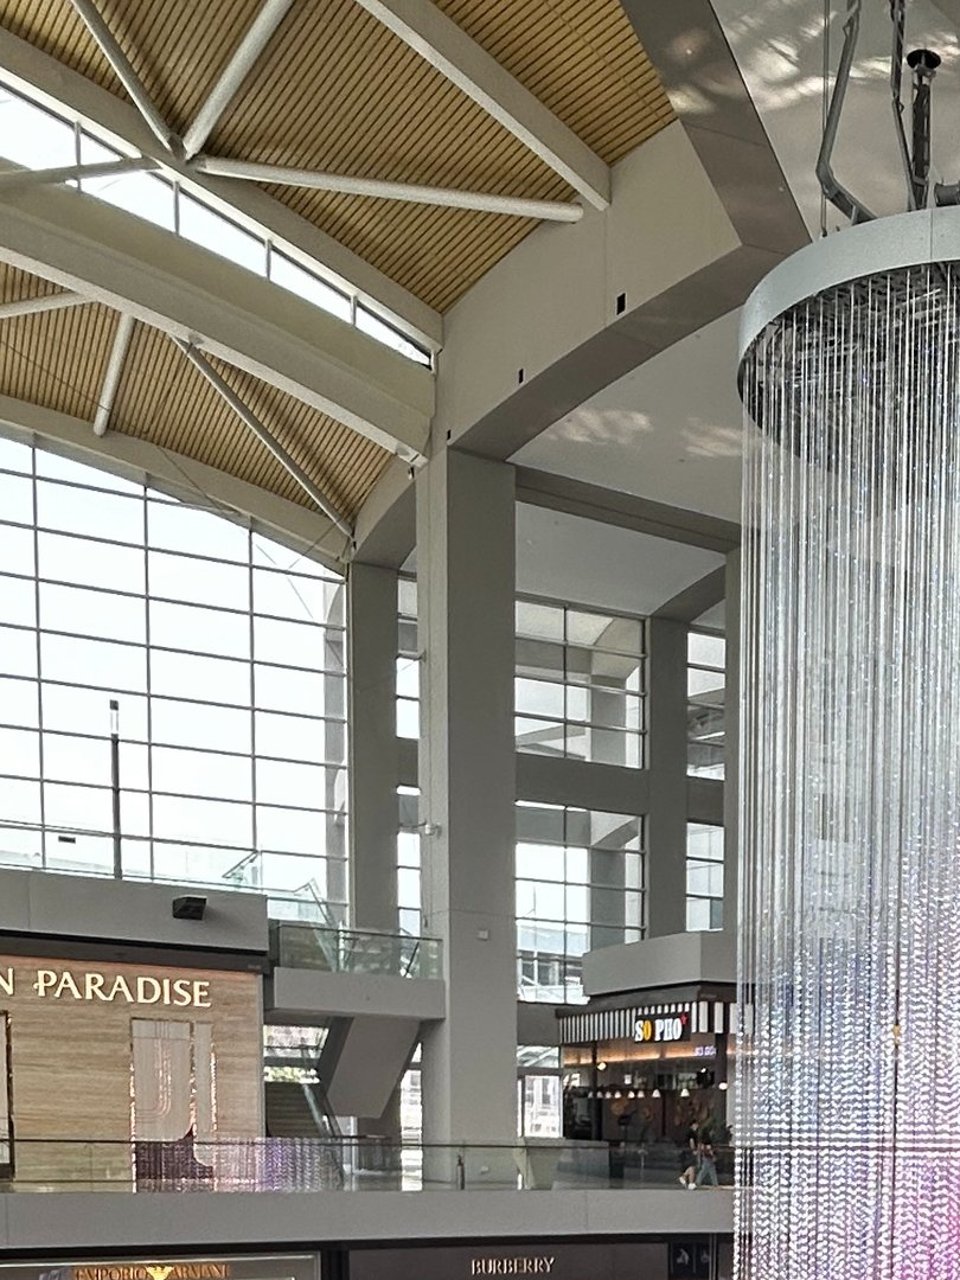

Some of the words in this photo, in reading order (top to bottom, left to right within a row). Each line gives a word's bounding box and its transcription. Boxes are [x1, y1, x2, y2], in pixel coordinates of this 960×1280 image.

[33, 970, 212, 1007] PARADISE
[635, 1020, 651, 1041] SO
[655, 1018, 682, 1041] PHO
[172, 1263, 229, 1280] ARMANI
[471, 1256, 555, 1275] BURBERRY
